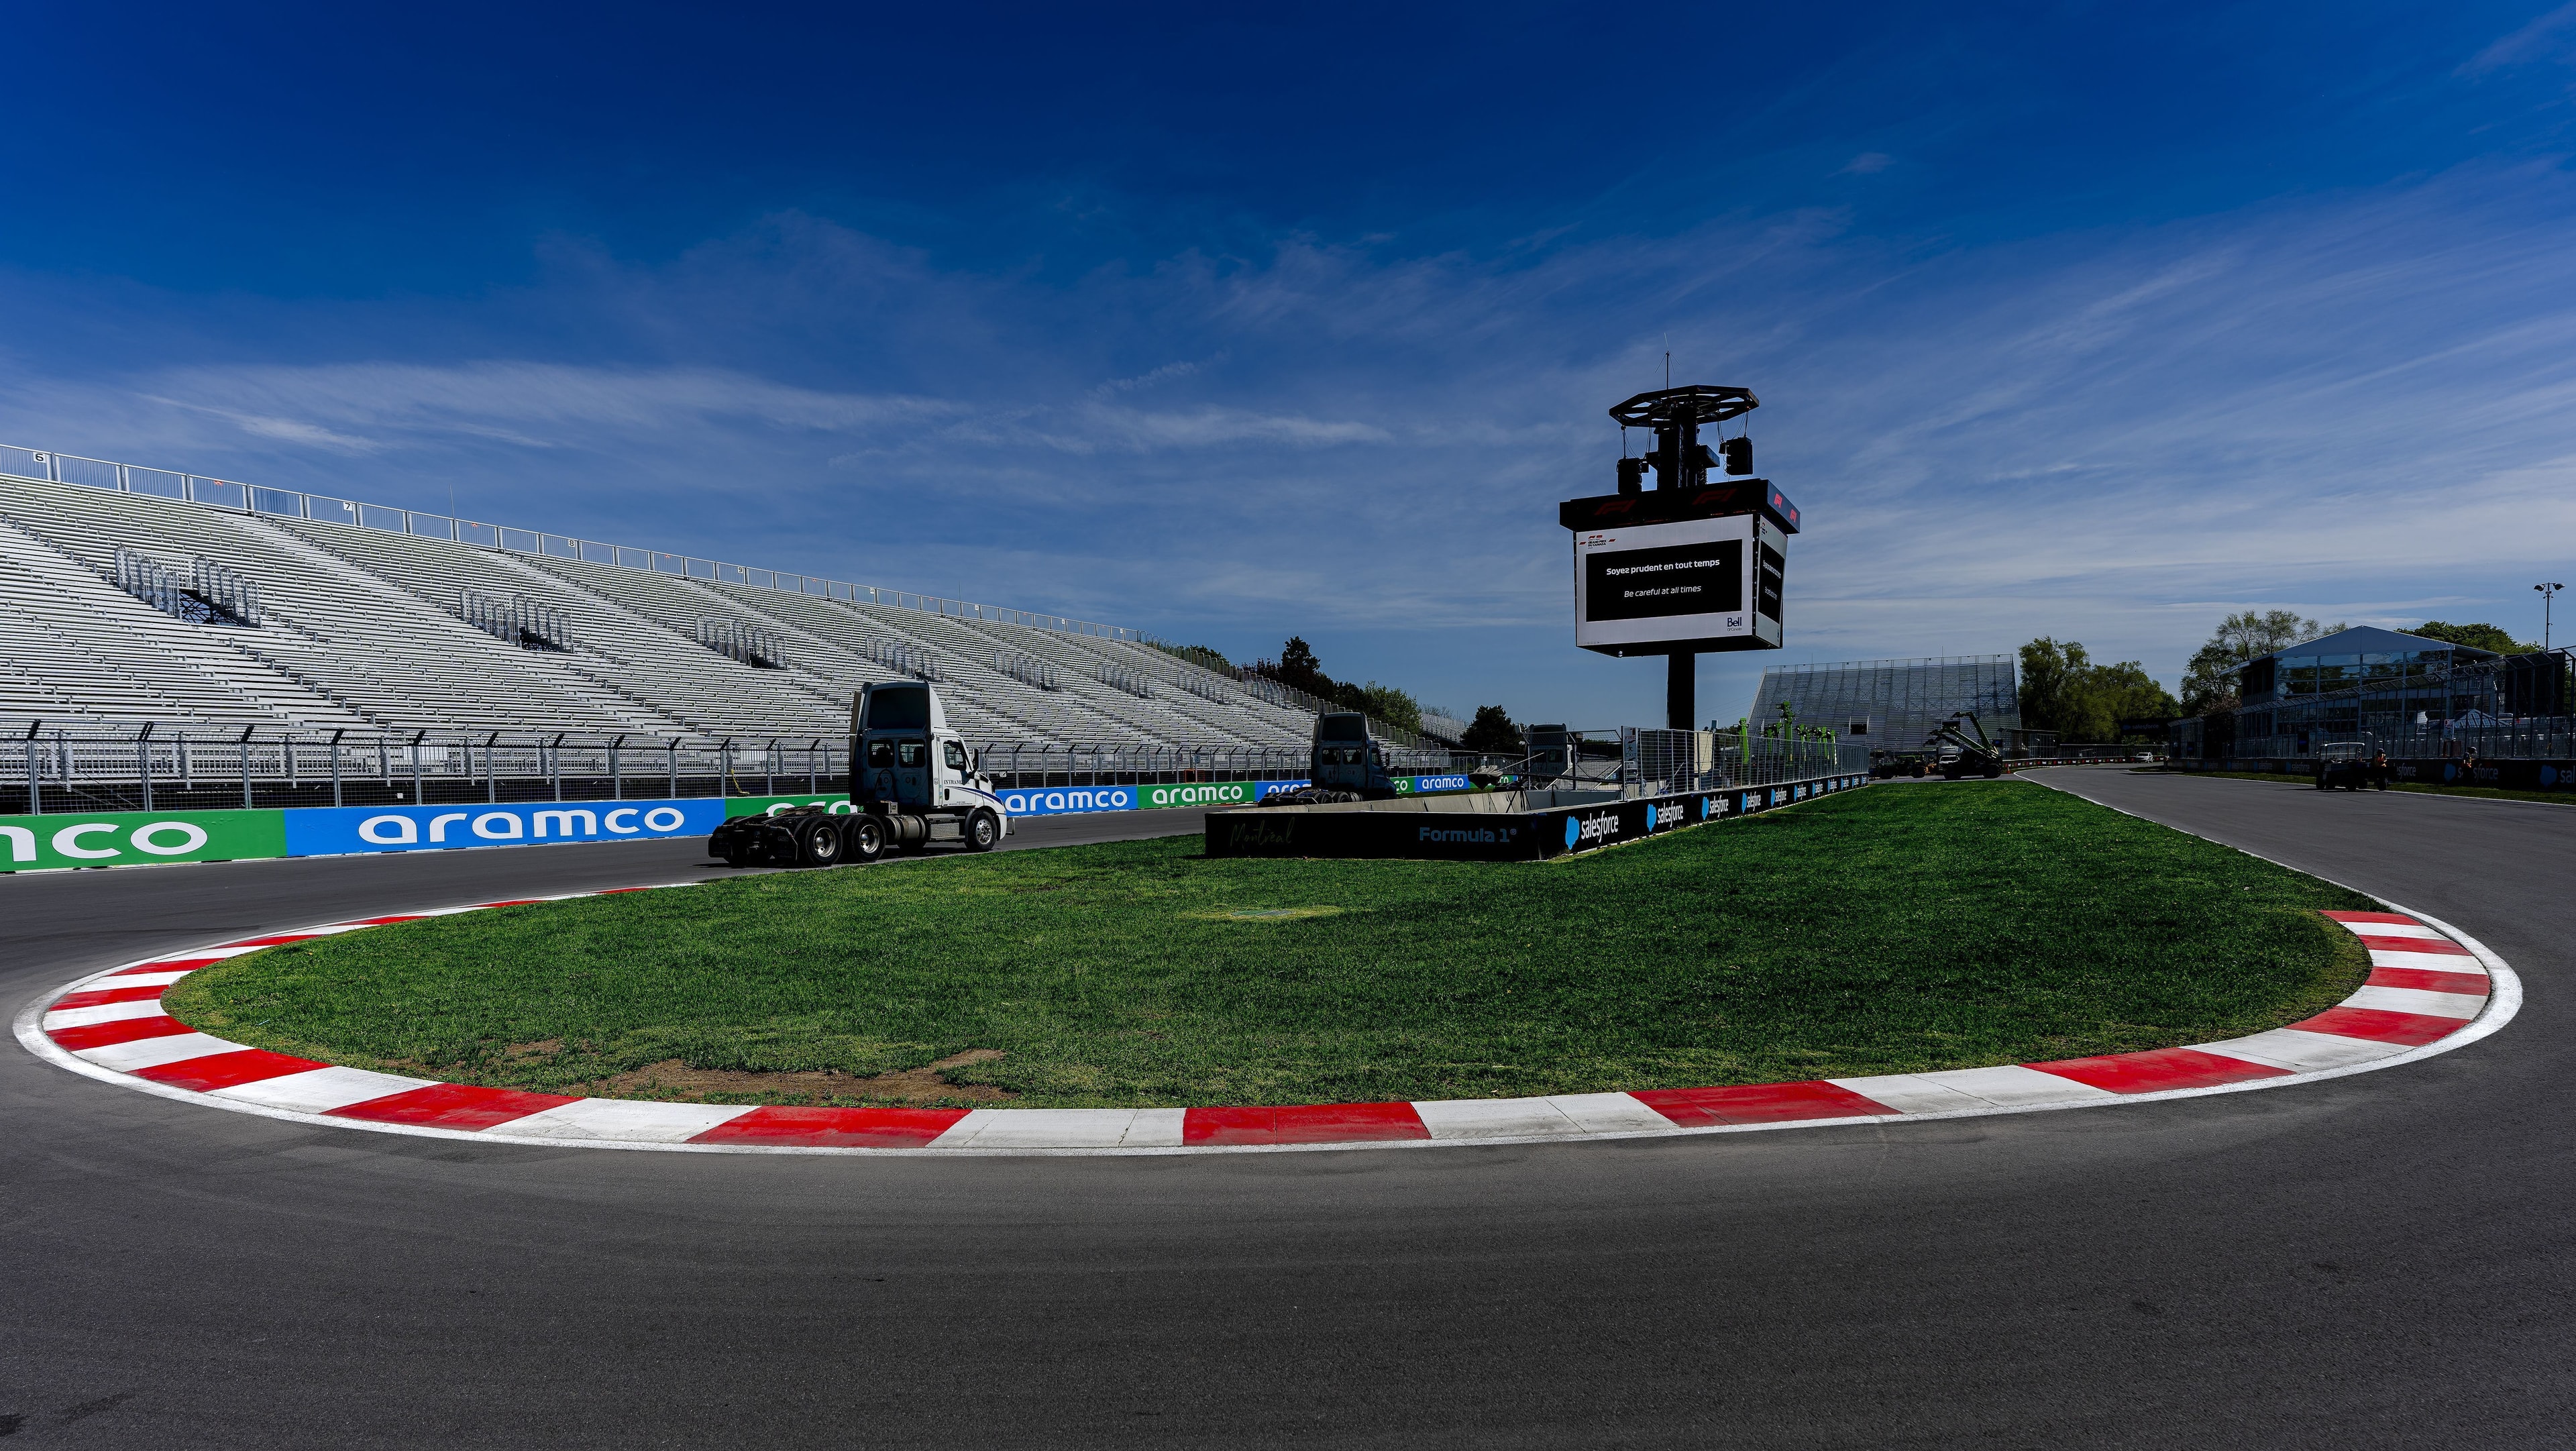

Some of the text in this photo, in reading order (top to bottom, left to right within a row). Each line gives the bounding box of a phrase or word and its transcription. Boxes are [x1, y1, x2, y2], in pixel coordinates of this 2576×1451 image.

[35, 453, 44, 462] 6
[1607, 568, 1630, 576] Soyez
[1631, 563, 1662, 574] prudent
[1675, 561, 1693, 569] tout
[1694, 559, 1720, 568] temps
[1635, 588, 1660, 596] careful
[1727, 616, 1742, 627] Bell
[1421, 777, 1464, 790] aramco
[1006, 790, 1128, 813] aramco
[1152, 786, 1244, 804] aramco
[1746, 791, 1762, 812] salesforce
[1657, 800, 1684, 828] salesforce
[1709, 794, 1729, 818] salesforce
[358, 807, 685, 844] aramco
[1419, 826, 1495, 843] Formula
[1580, 810, 1619, 843] salesforce
